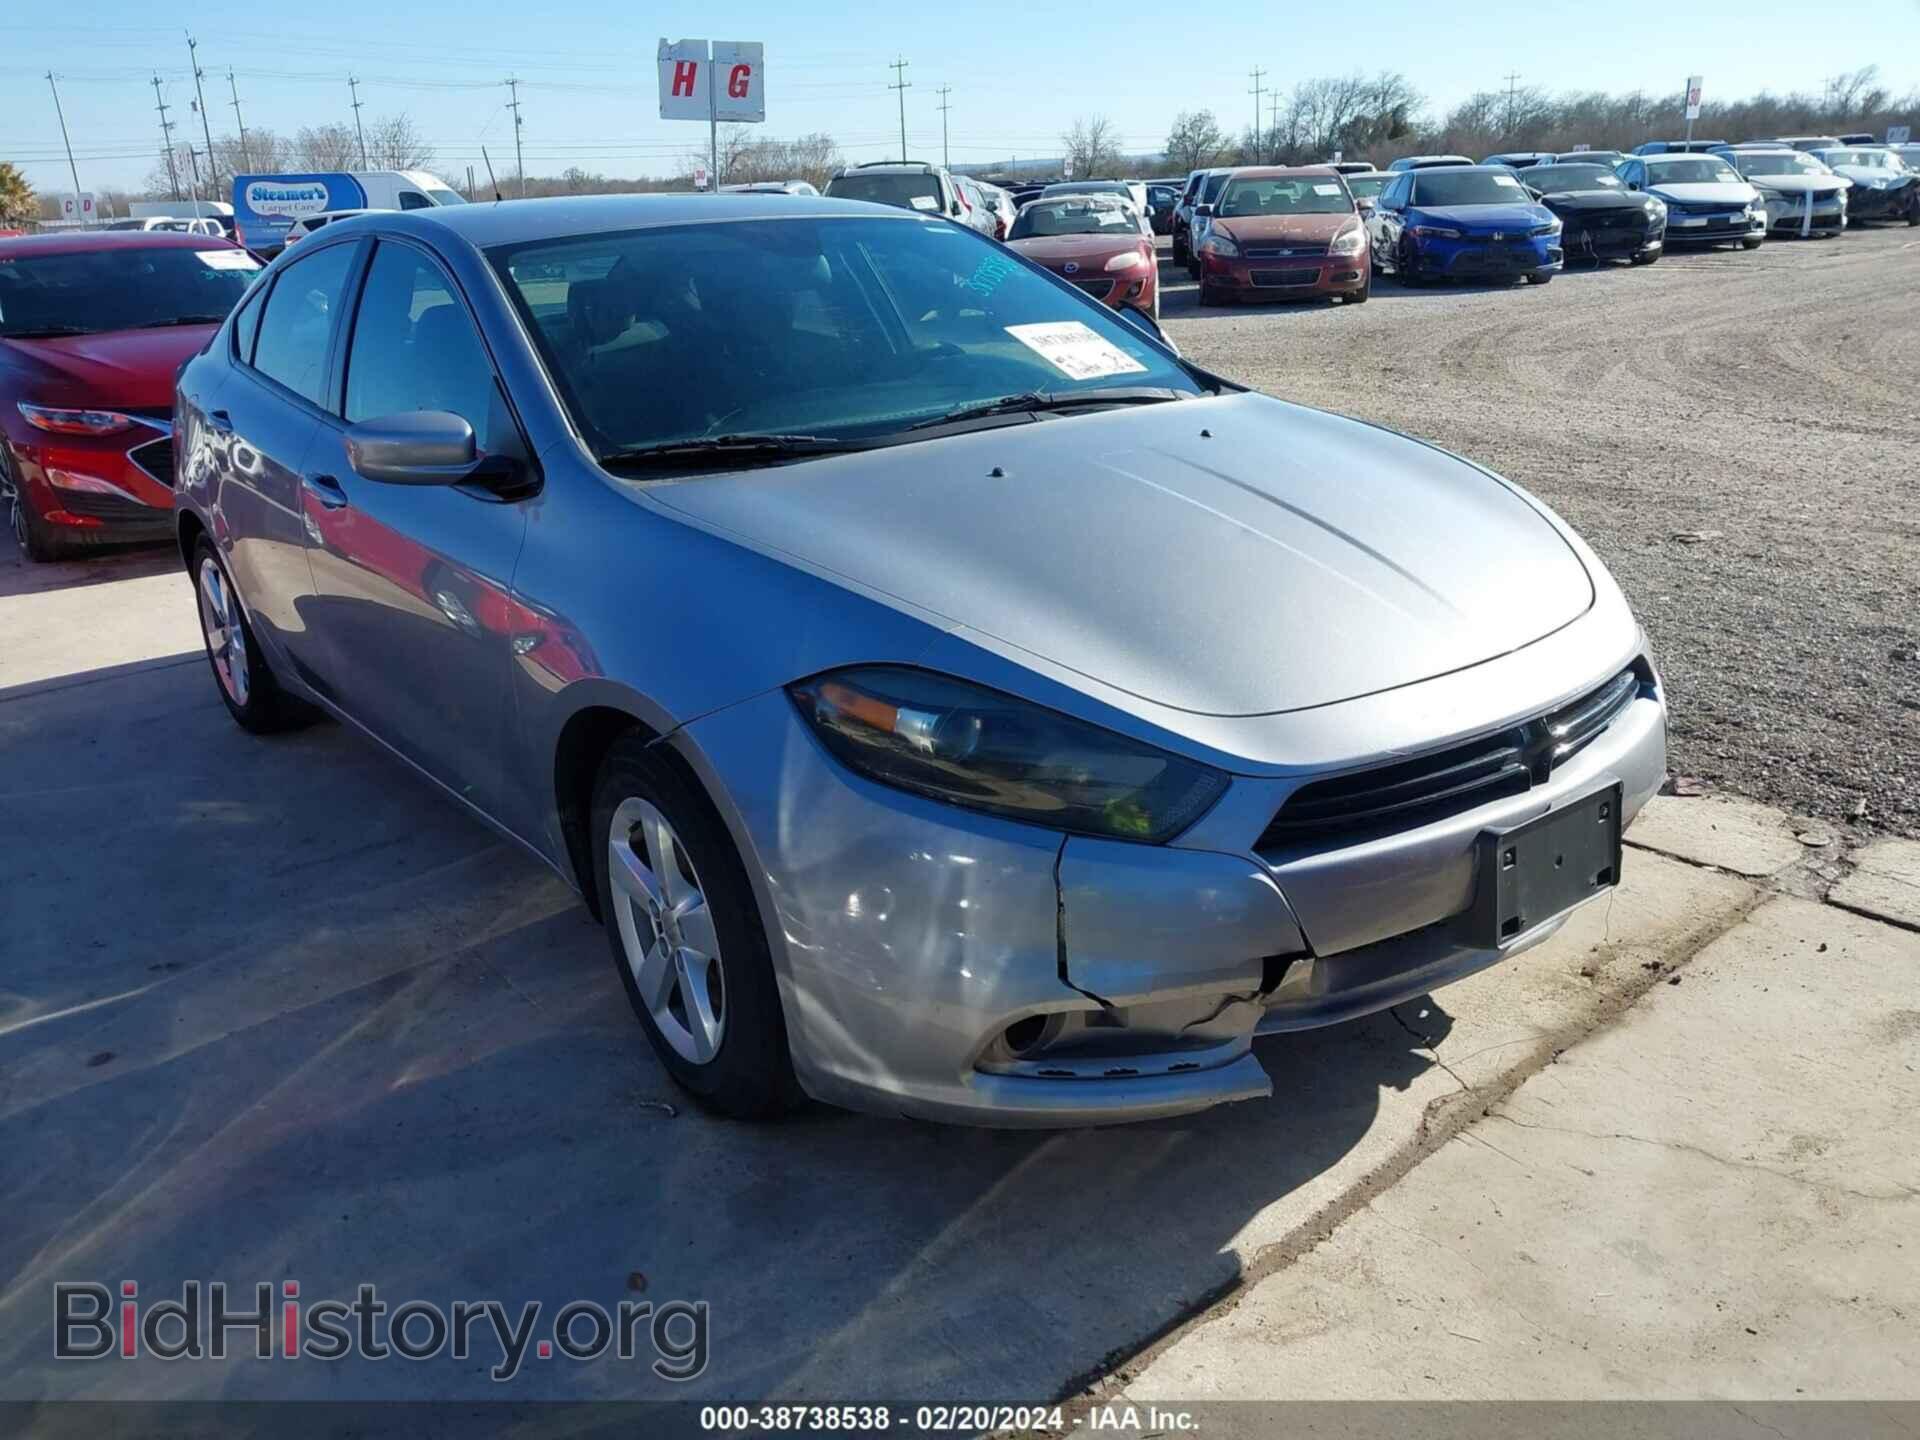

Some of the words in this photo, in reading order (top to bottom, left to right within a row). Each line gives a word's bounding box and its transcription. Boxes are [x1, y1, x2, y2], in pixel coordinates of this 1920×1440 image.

[672, 61, 698, 97] H
[728, 64, 751, 98] G
[252, 186, 326, 201] Steamer's
[65, 200, 73, 213] C
[83, 199, 92, 212] D
